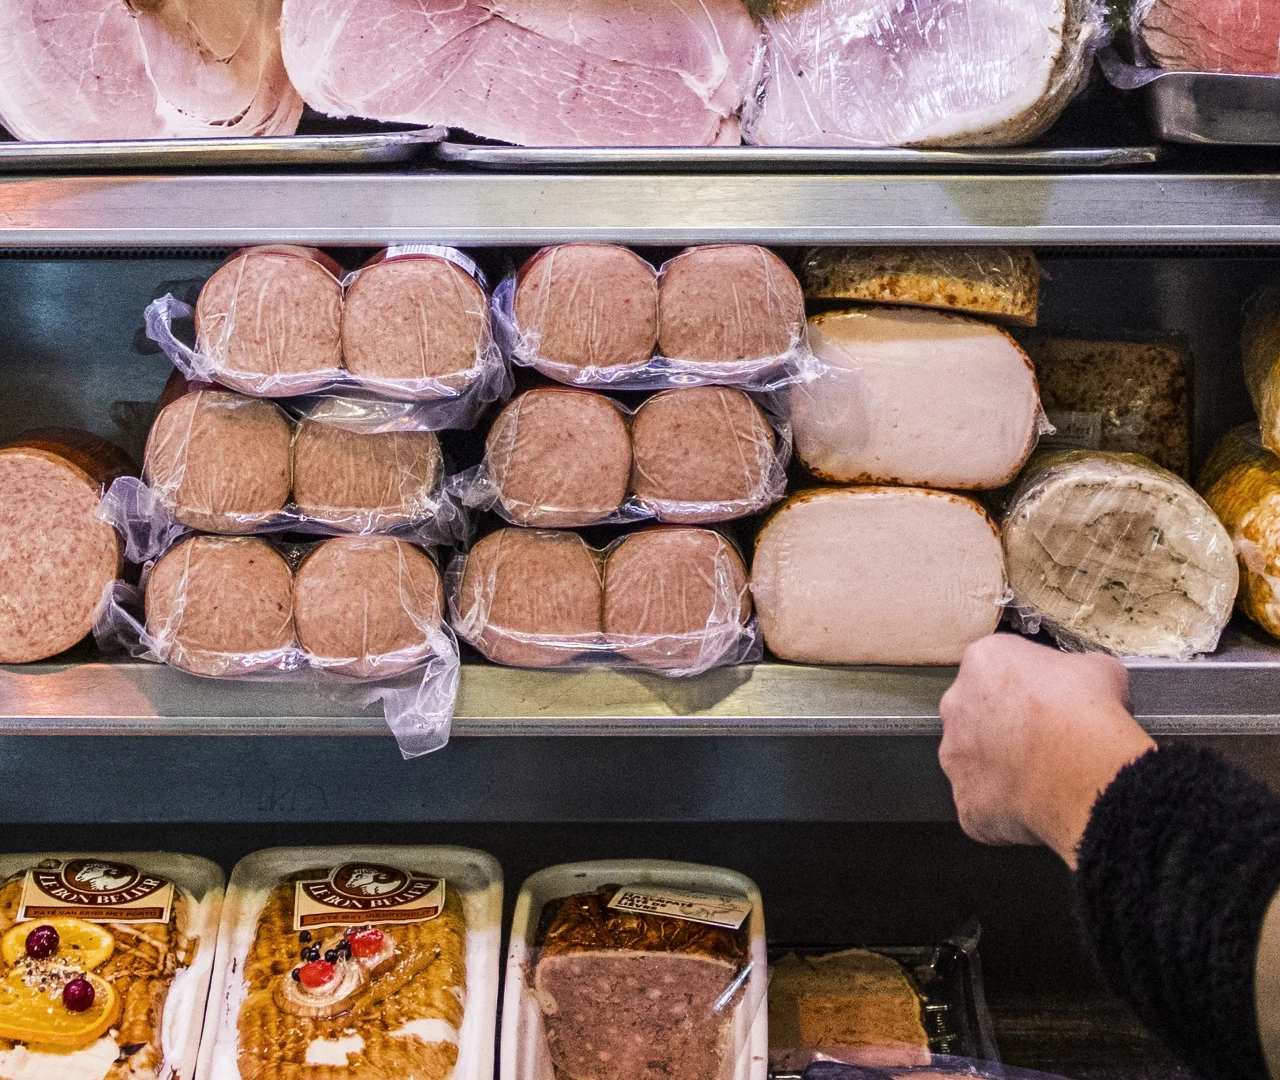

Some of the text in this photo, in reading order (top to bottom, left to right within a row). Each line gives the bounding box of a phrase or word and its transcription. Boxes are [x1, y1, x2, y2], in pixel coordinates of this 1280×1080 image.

[39, 874, 60, 889] LE
[51, 887, 92, 904] BON
[309, 884, 331, 896] LE
[322, 894, 365, 908] BON
